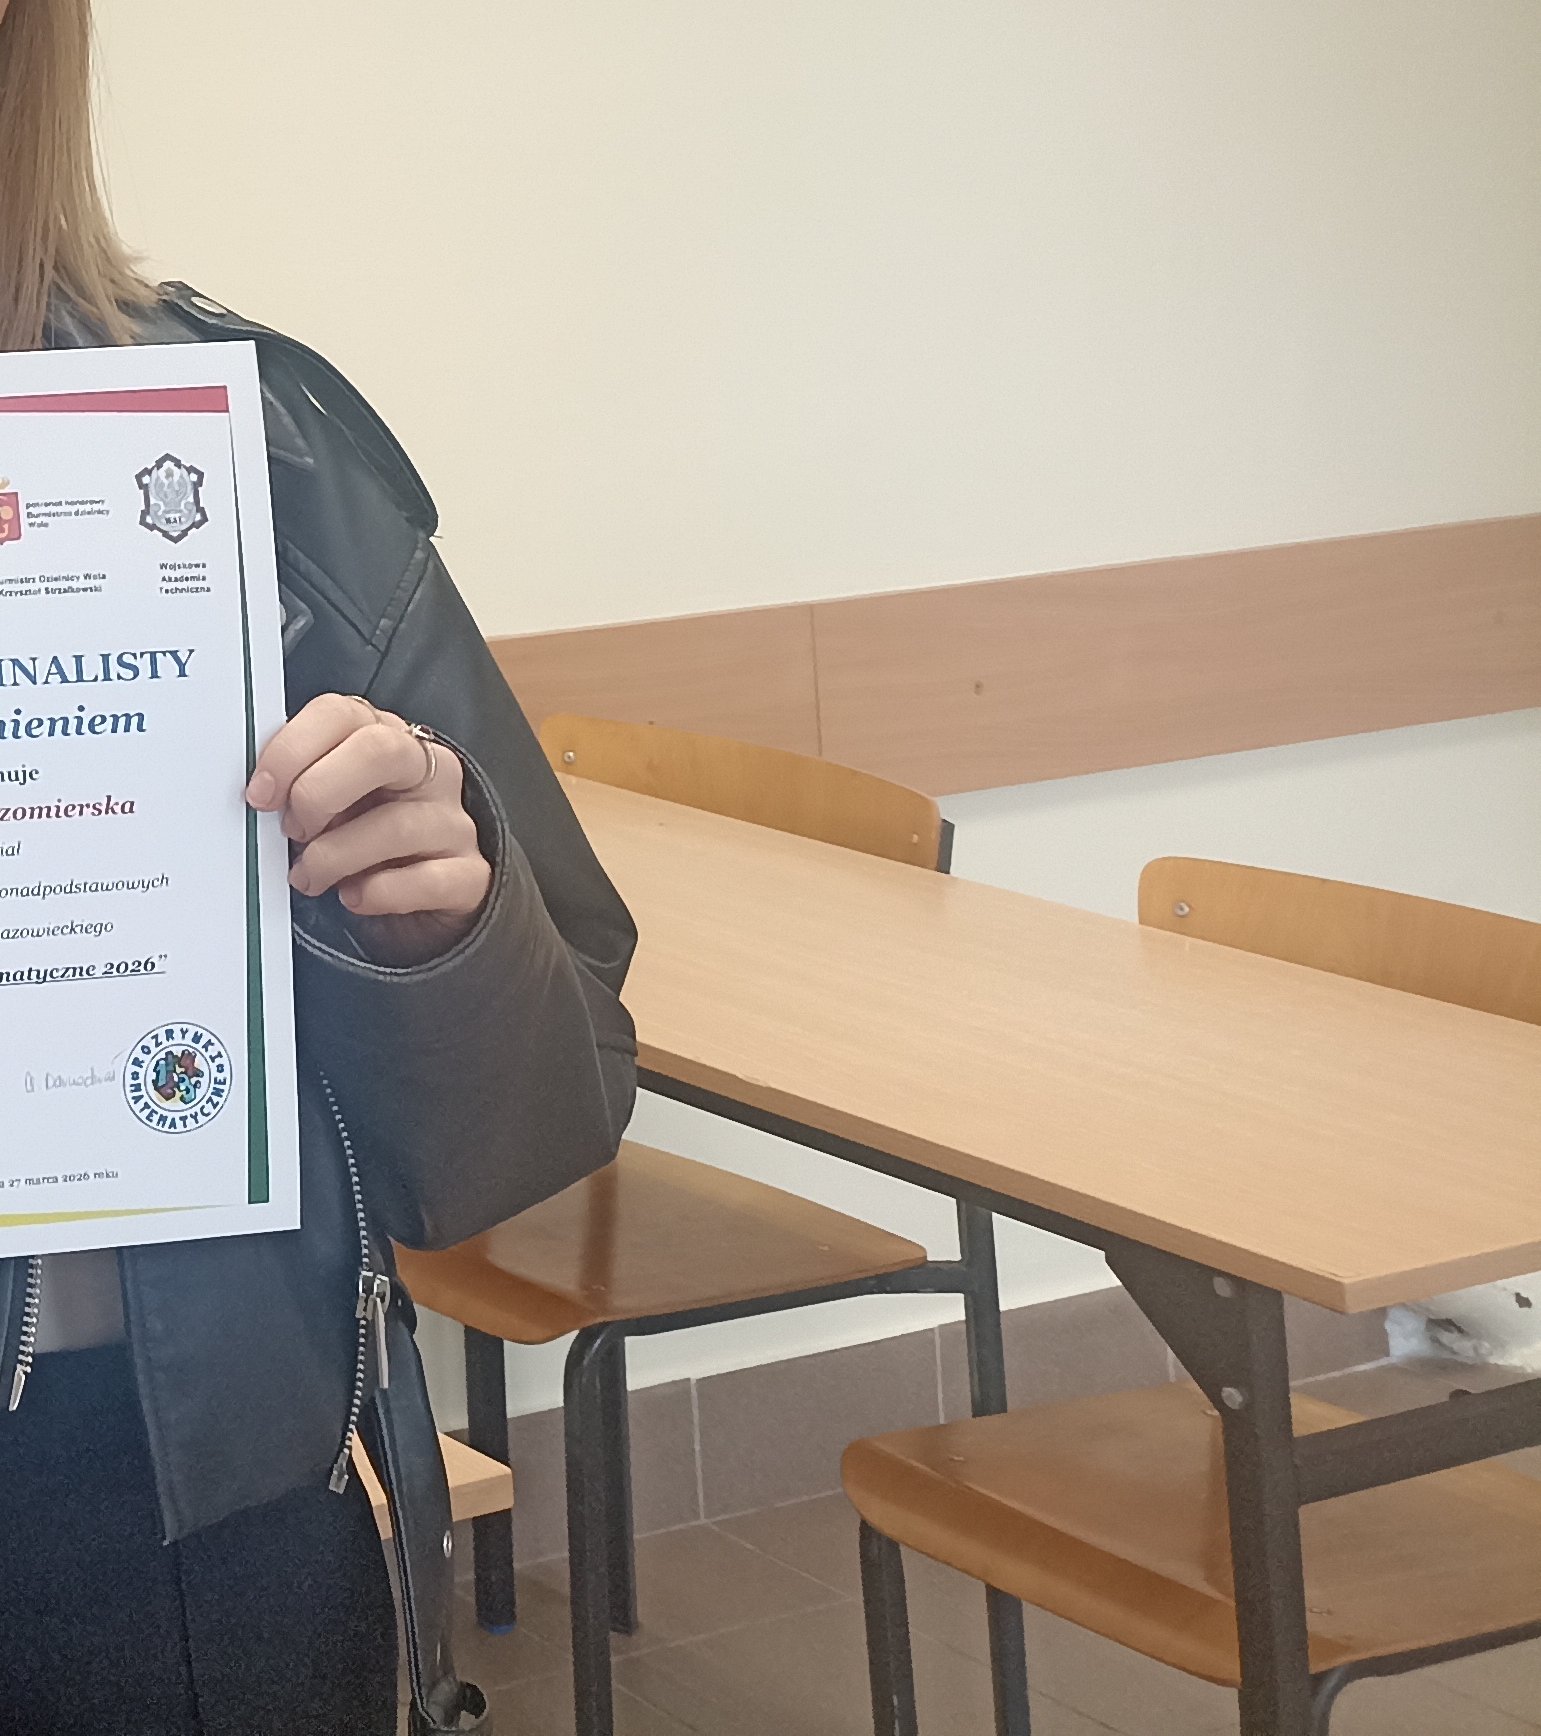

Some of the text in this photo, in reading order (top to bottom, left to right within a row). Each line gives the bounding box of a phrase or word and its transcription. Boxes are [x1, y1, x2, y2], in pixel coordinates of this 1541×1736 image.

[101, 954, 168, 975] 2026”
[131, 1027, 223, 1068] ROZRYWKI
[130, 1076, 227, 1129] MATEMATYCZNE
